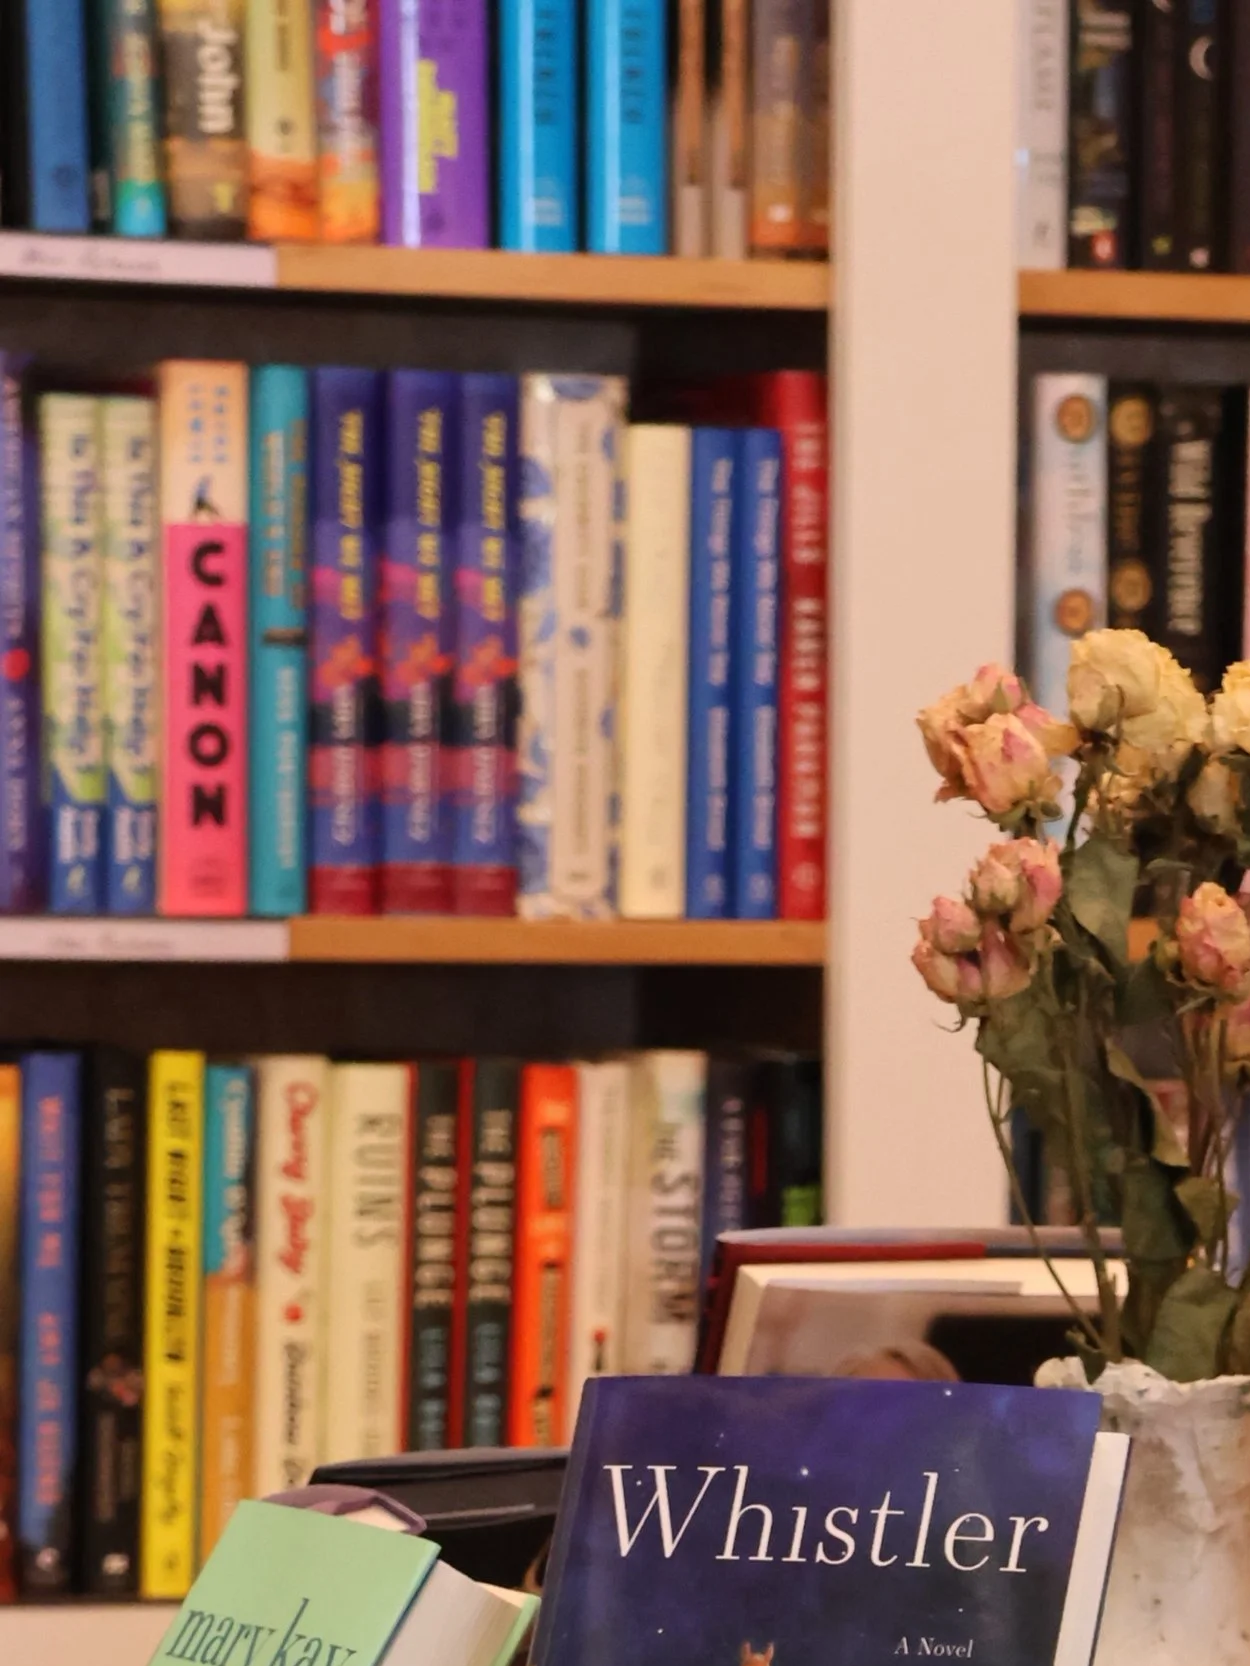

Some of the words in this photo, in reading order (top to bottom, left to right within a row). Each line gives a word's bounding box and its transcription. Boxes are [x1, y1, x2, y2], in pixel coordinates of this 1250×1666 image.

[190, 538, 231, 830] CANON
[354, 1113, 404, 1249] RUINS
[414, 1164, 459, 1309] PLUNGE
[468, 1160, 516, 1305] PLUNGE
[650, 1171, 704, 1324] STORM
[603, 1464, 1050, 1573] Whistler
[894, 1637, 912, 1657] A
[917, 1637, 974, 1659] Novel
